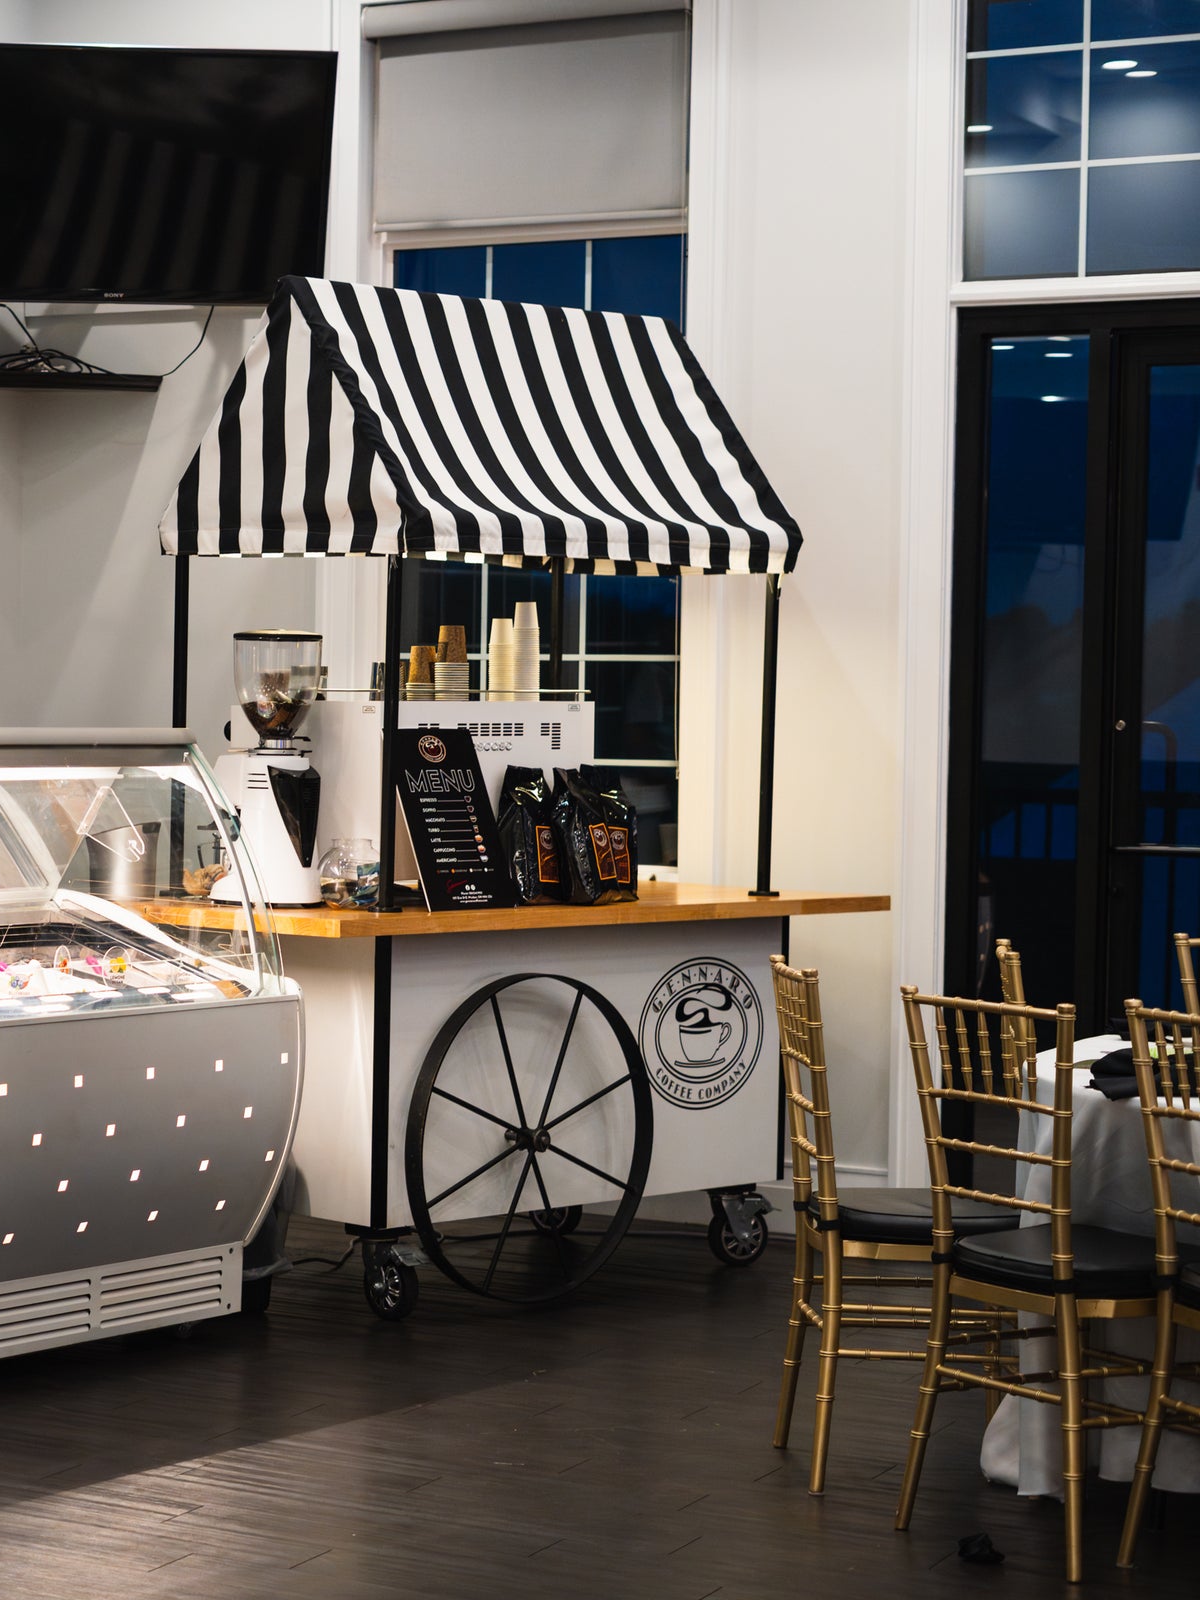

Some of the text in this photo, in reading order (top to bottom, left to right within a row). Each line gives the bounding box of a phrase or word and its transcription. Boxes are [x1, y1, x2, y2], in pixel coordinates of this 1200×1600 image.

[404, 768, 475, 793] MENU
[655, 1059, 747, 1100] COFFEE COMPANY
